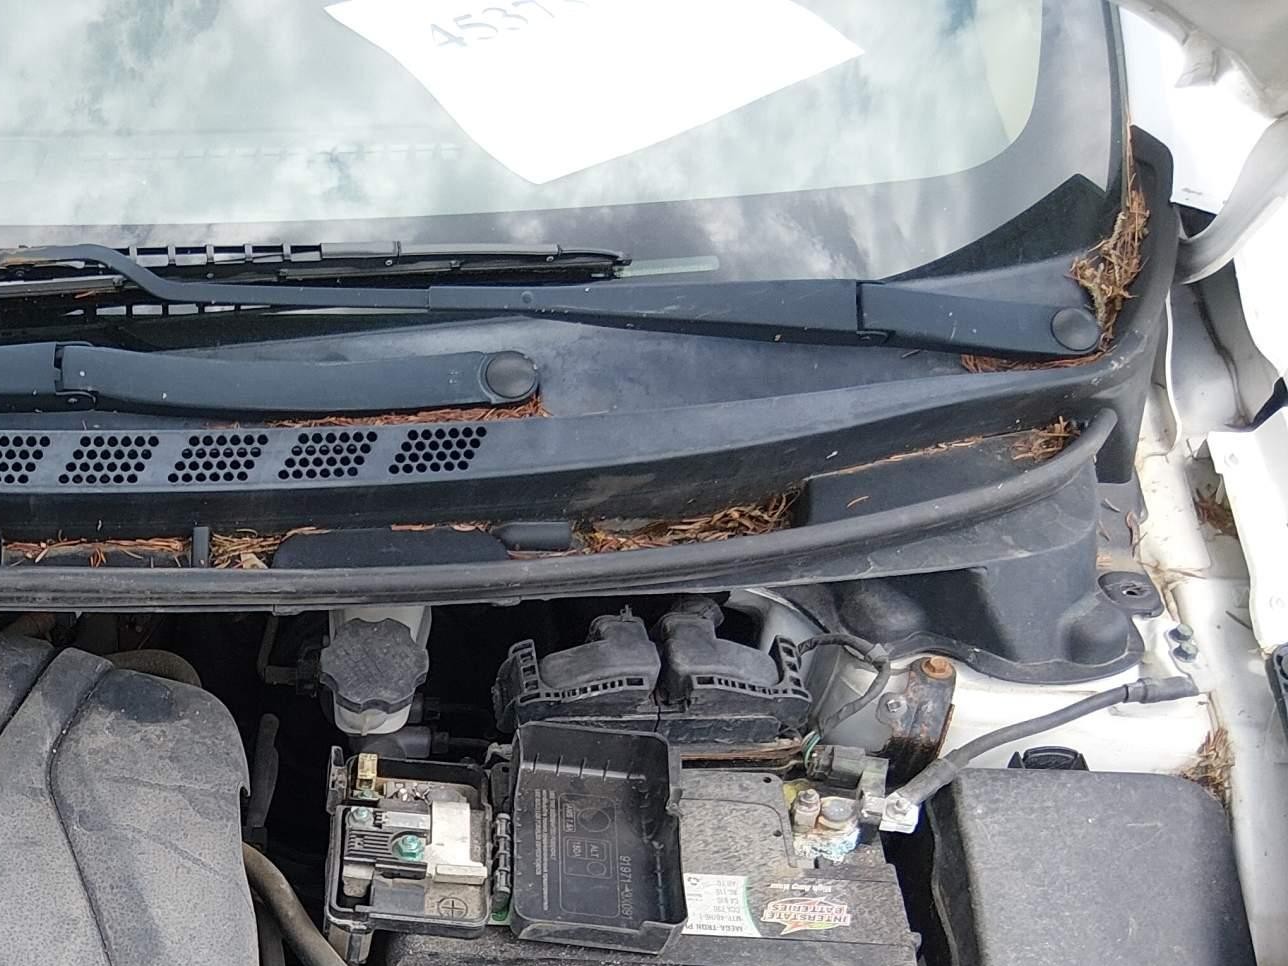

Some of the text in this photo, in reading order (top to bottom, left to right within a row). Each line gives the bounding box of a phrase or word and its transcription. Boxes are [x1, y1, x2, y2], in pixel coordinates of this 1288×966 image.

[589, 844, 600, 858] ALT
[770, 903, 844, 915] BATTERIES
[767, 910, 849, 924] INTERSTATE
